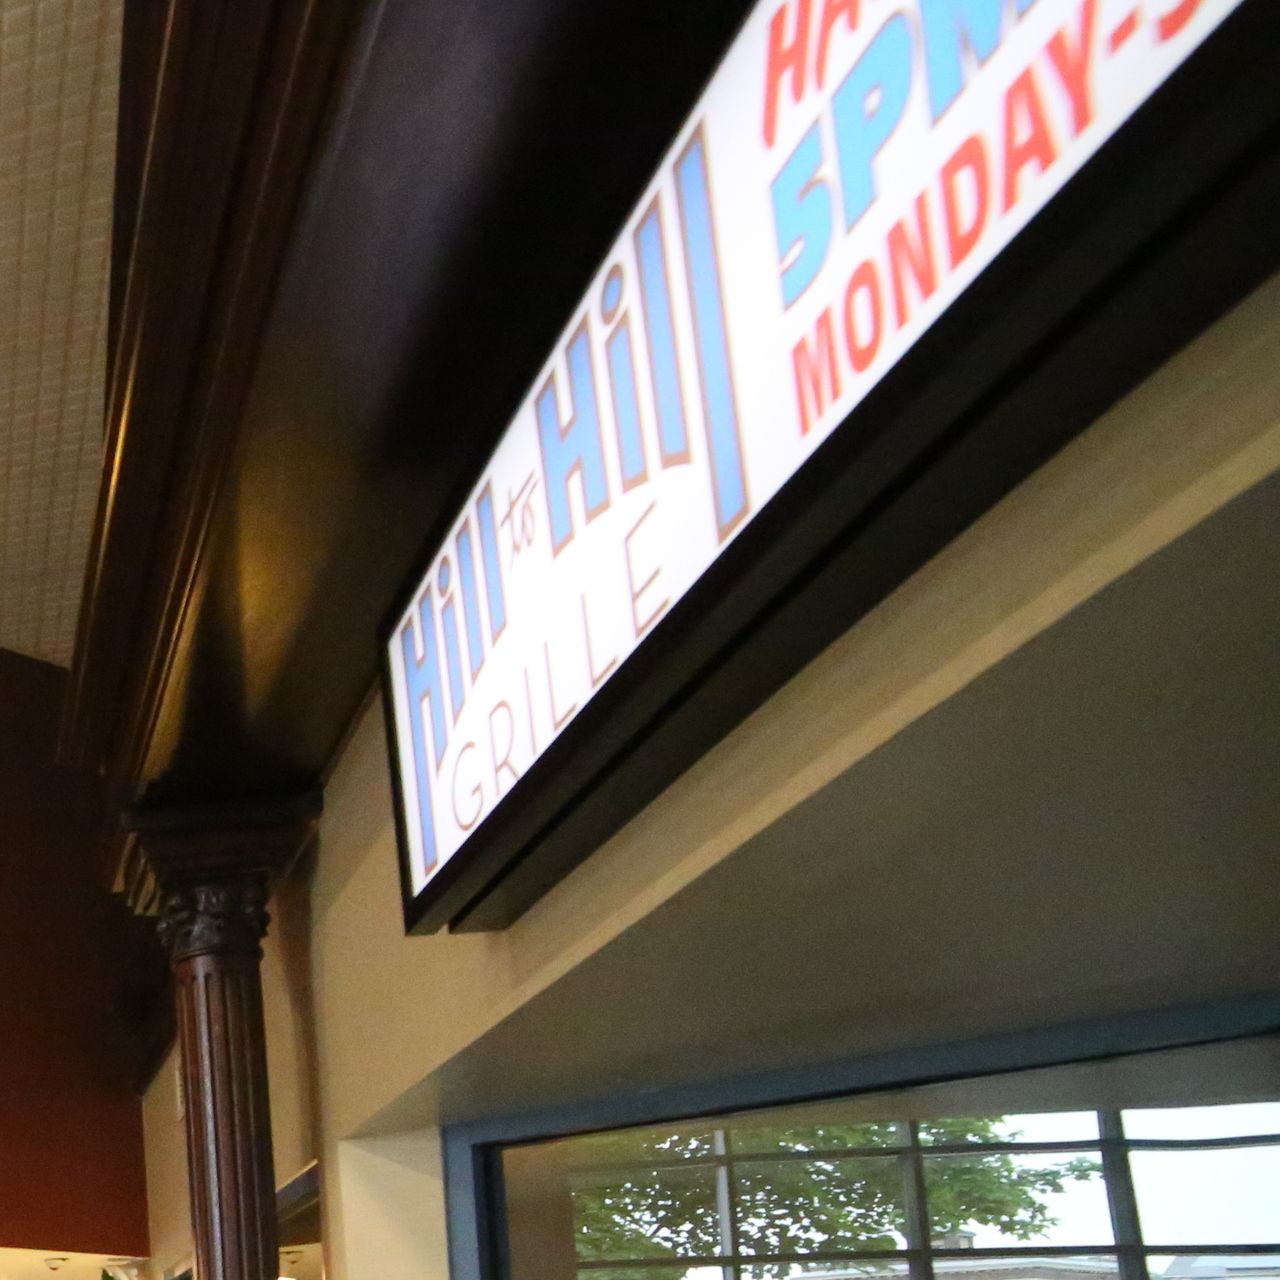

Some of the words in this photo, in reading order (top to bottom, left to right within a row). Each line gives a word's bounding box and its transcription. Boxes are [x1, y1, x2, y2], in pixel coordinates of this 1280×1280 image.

[400, 475, 507, 880] Hill
[499, 469, 540, 573] to
[533, 112, 751, 560] Hill
[449, 500, 671, 832] GRILLE
